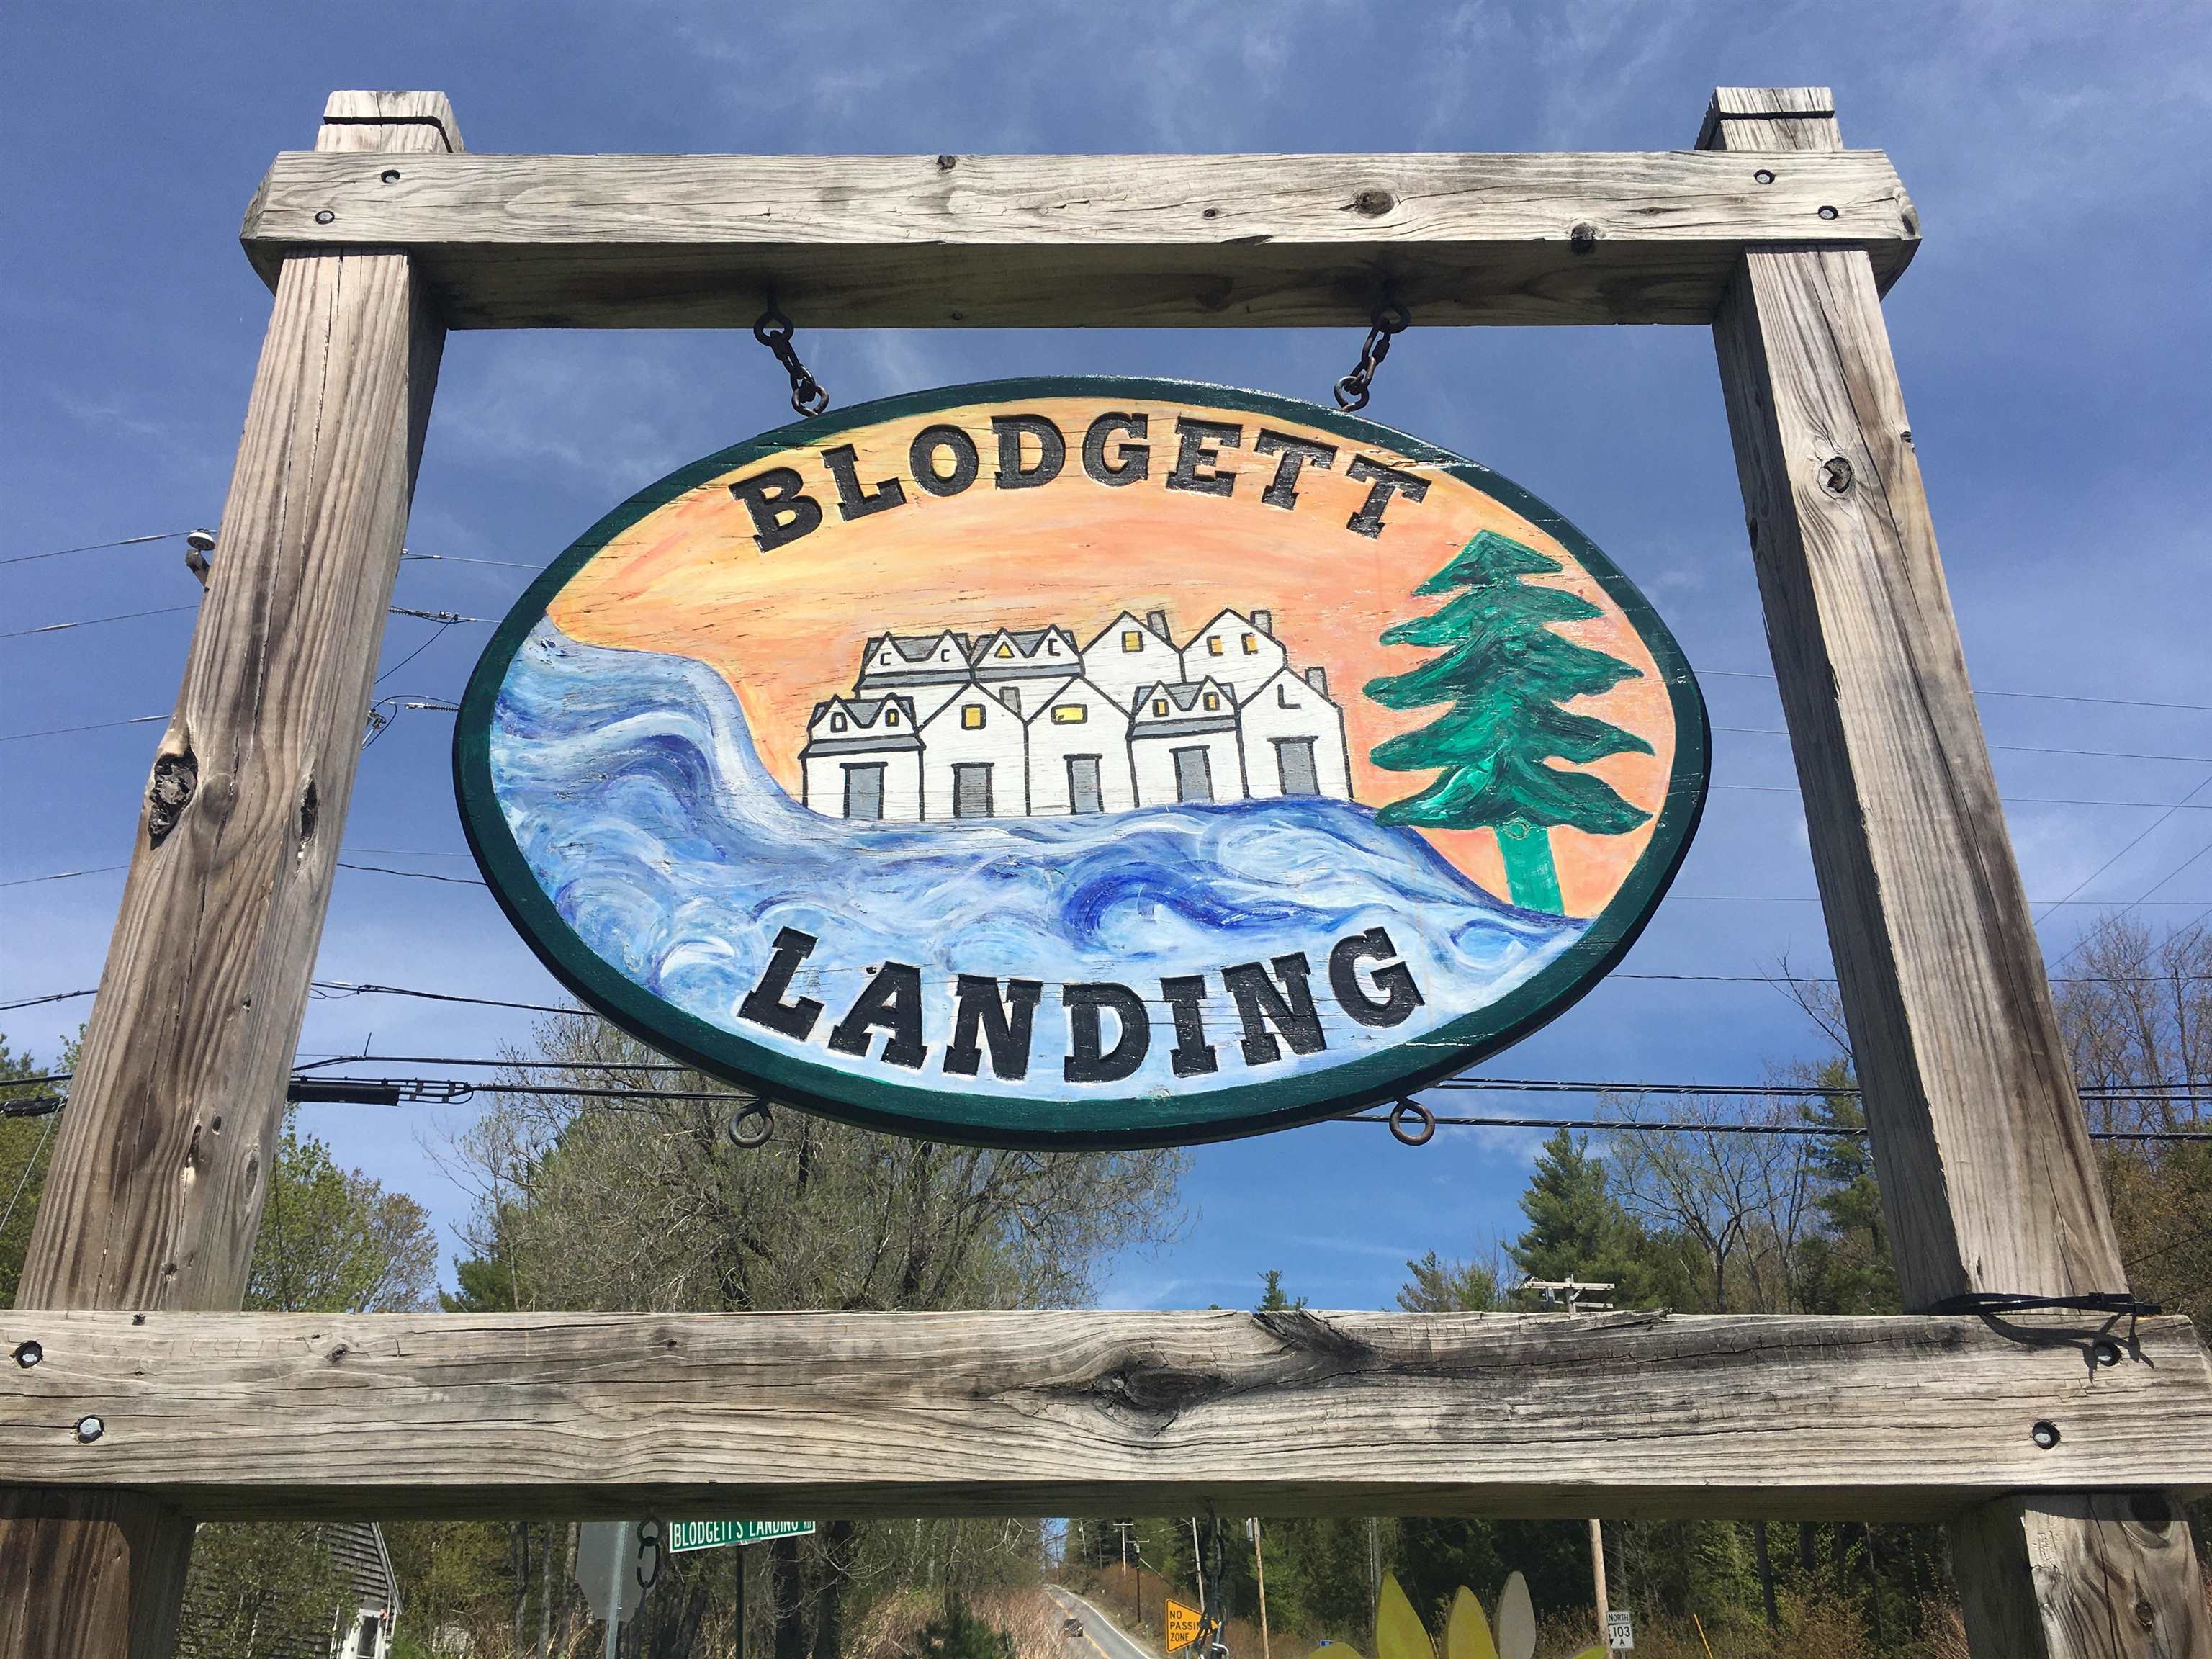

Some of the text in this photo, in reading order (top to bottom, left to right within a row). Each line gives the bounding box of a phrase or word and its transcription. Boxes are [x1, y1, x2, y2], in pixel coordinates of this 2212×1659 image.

[729, 411, 1433, 554] BLODGETT
[739, 925, 1425, 1084] LANDING
[674, 1521, 744, 1547] BLODGETTS
[1169, 1610, 1182, 1619] NO
[1169, 1622, 1200, 1630] PASSIN
[1613, 1626, 1631, 1637] 103
[1170, 1632, 1190, 1642] ZONE
